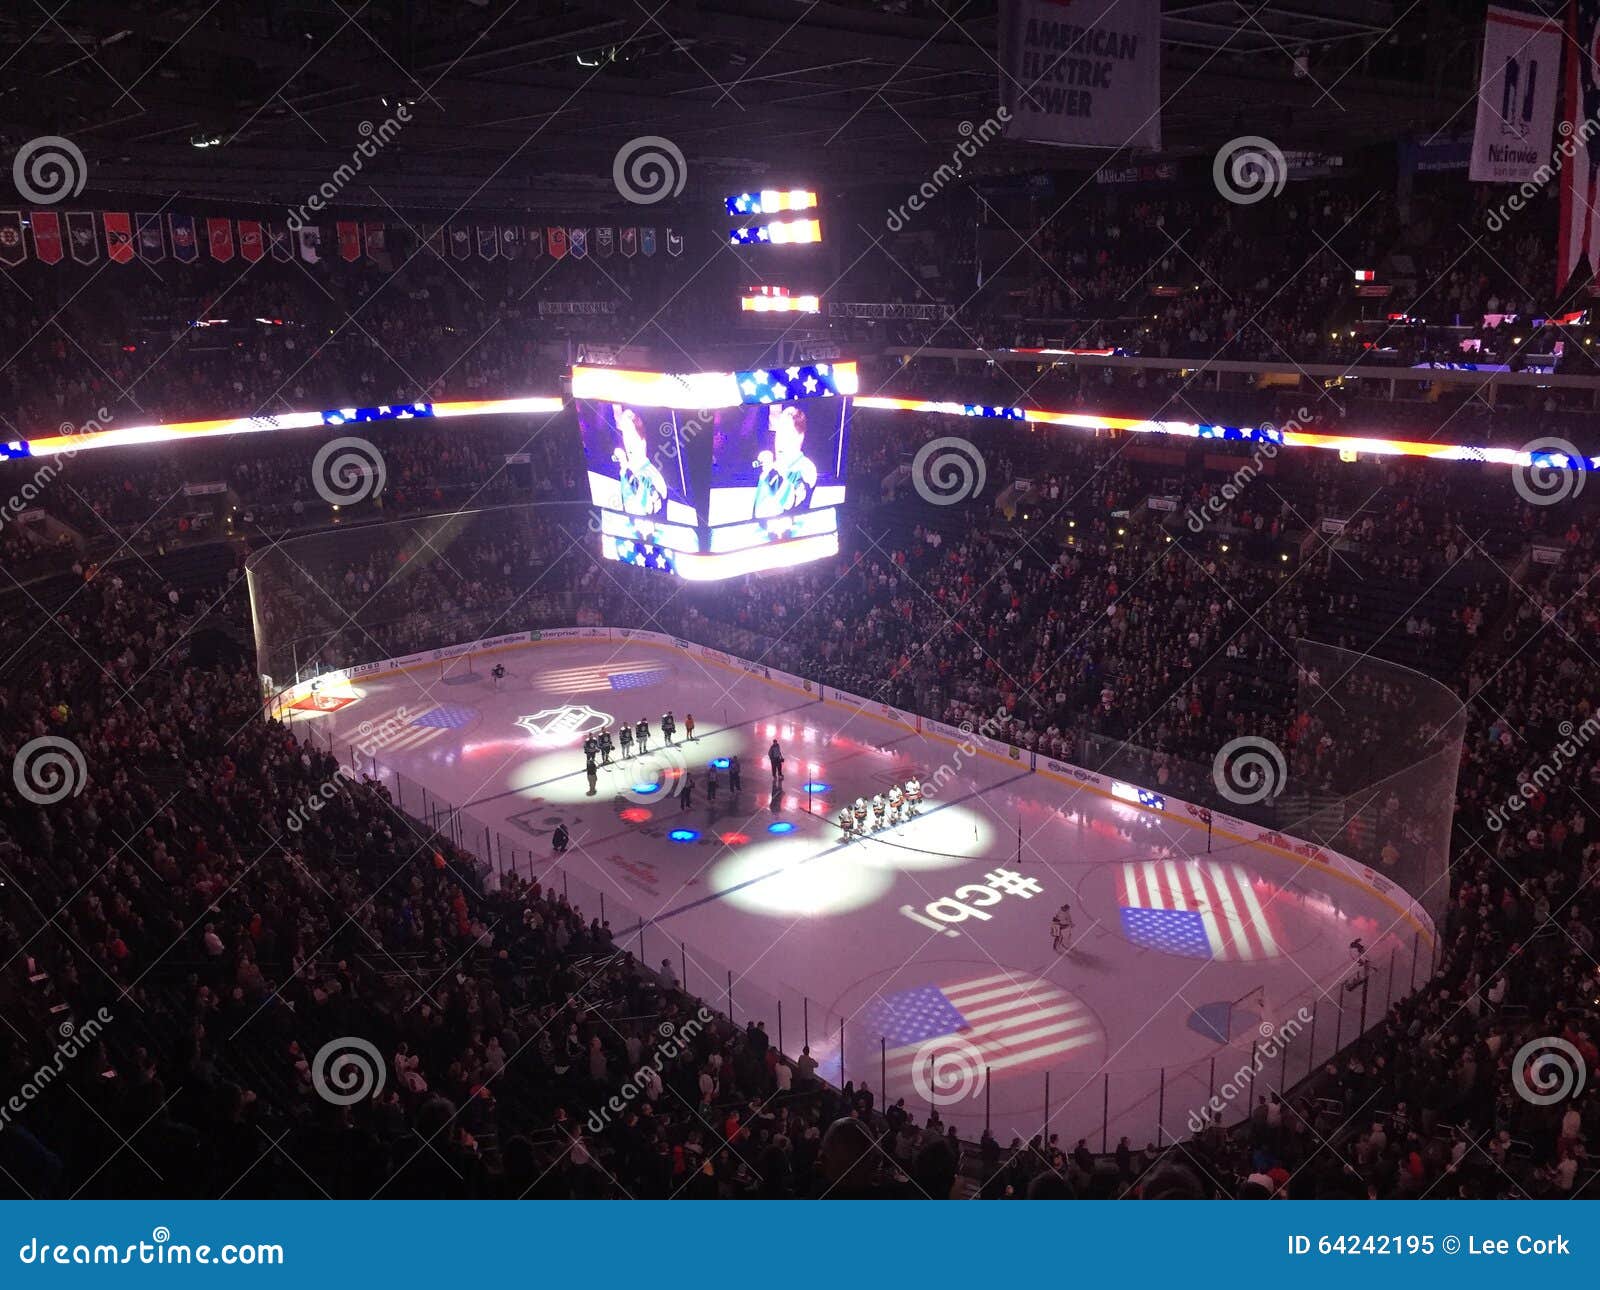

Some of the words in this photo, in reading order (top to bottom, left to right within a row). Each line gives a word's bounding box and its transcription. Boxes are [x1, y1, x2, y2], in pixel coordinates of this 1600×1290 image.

[1024, 18, 1137, 61] AMERICAN
[1022, 51, 1113, 89] ELECTRIC
[1018, 86, 1093, 118] POWER
[899, 868, 1044, 938] #cbj
